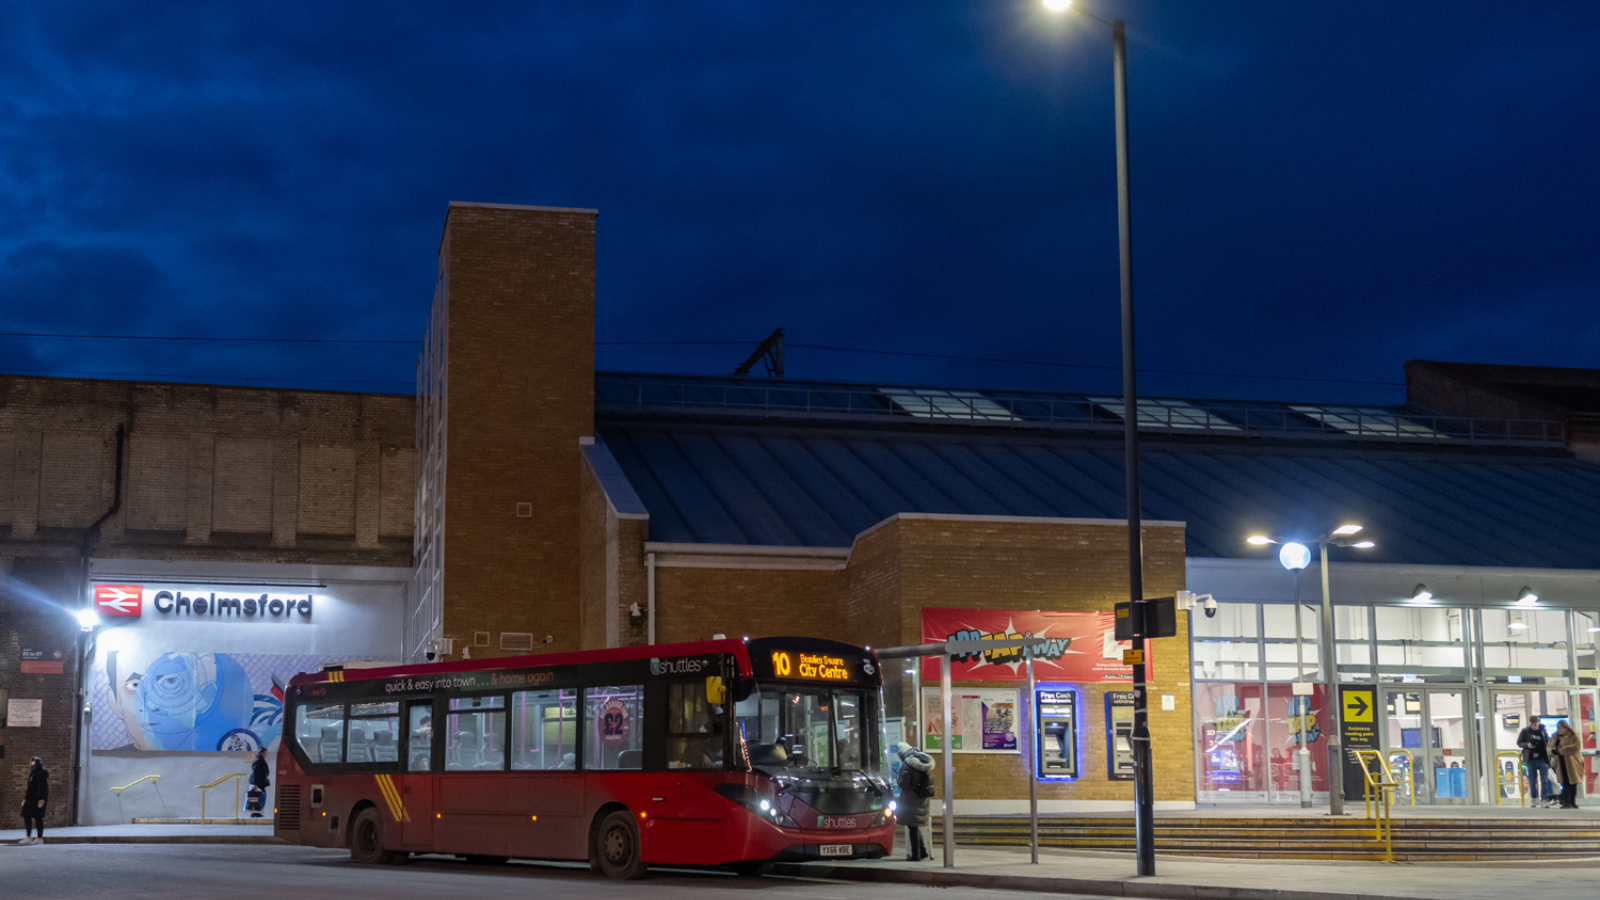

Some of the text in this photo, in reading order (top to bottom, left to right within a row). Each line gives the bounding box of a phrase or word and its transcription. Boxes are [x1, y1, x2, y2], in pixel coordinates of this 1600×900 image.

[154, 590, 313, 617] Chelmsford
[660, 657, 702, 674] shuttles
[772, 652, 791, 676] 10
[799, 663, 848, 679] City Centre
[385, 679, 406, 694] quick
[407, 678, 413, 691] &
[415, 680, 434, 692] easy
[435, 676, 452, 688] into
[491, 672, 497, 686] &
[500, 672, 526, 685] home
[527, 669, 554, 686] again
[1055, 691, 1071, 699] Cash
[604, 713, 624, 735] £2
[823, 816, 857, 828] shuttles
